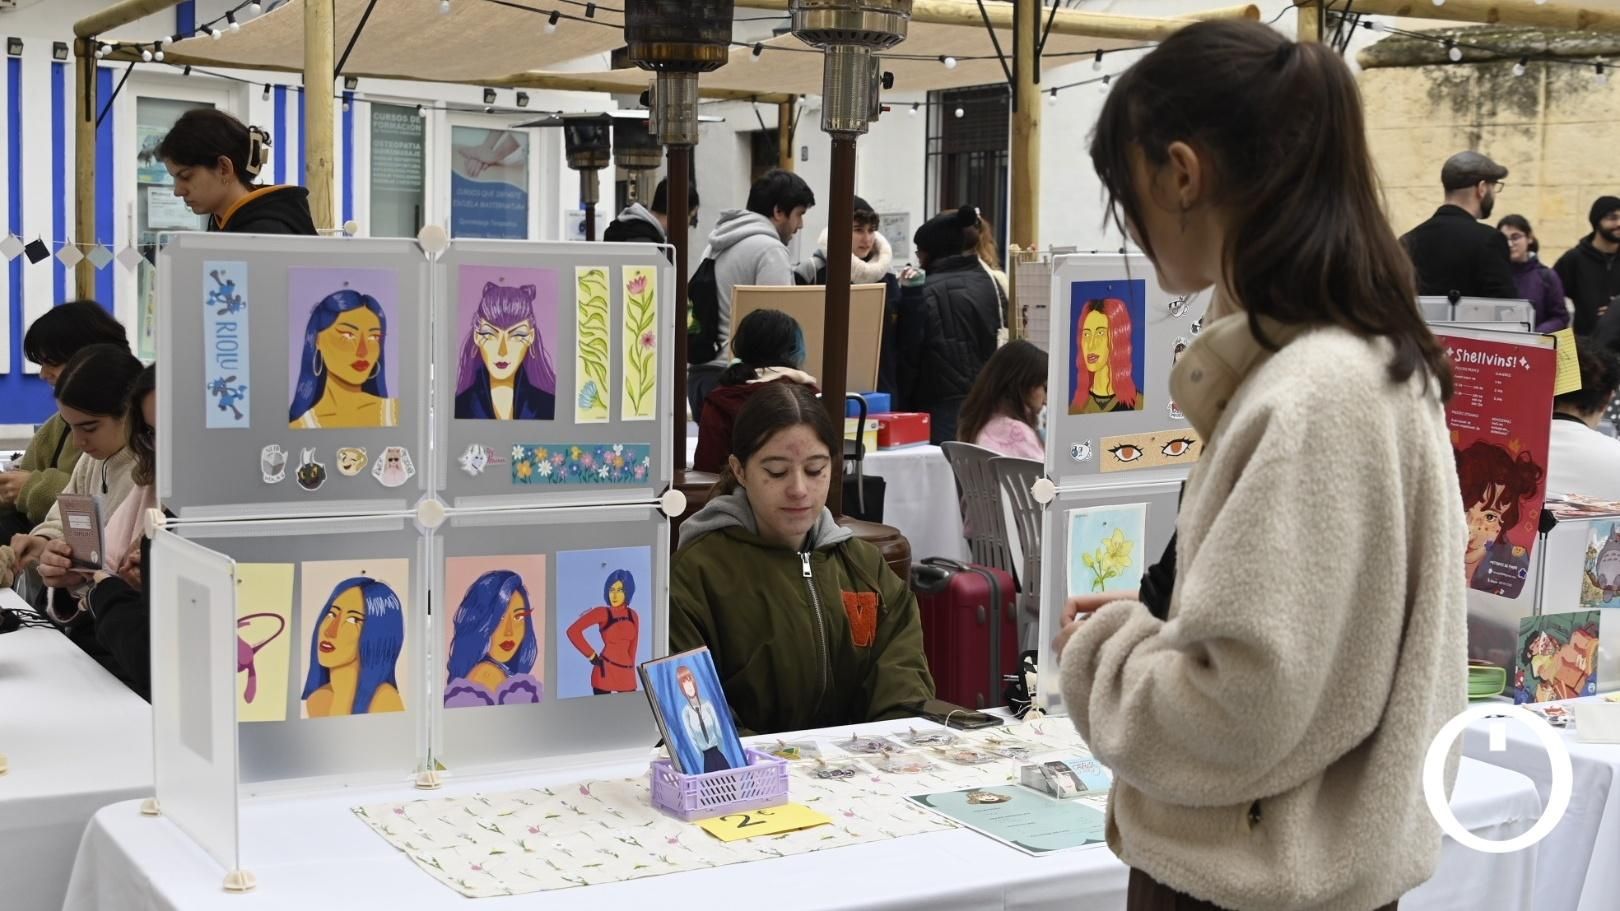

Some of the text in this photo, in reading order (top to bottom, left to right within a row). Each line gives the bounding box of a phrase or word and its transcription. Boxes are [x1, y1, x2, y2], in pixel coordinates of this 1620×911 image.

[373, 112, 421, 124] CURSOS DE
[215, 321, 239, 371] RIOLU
[1454, 348, 1517, 368] Shellvins!
